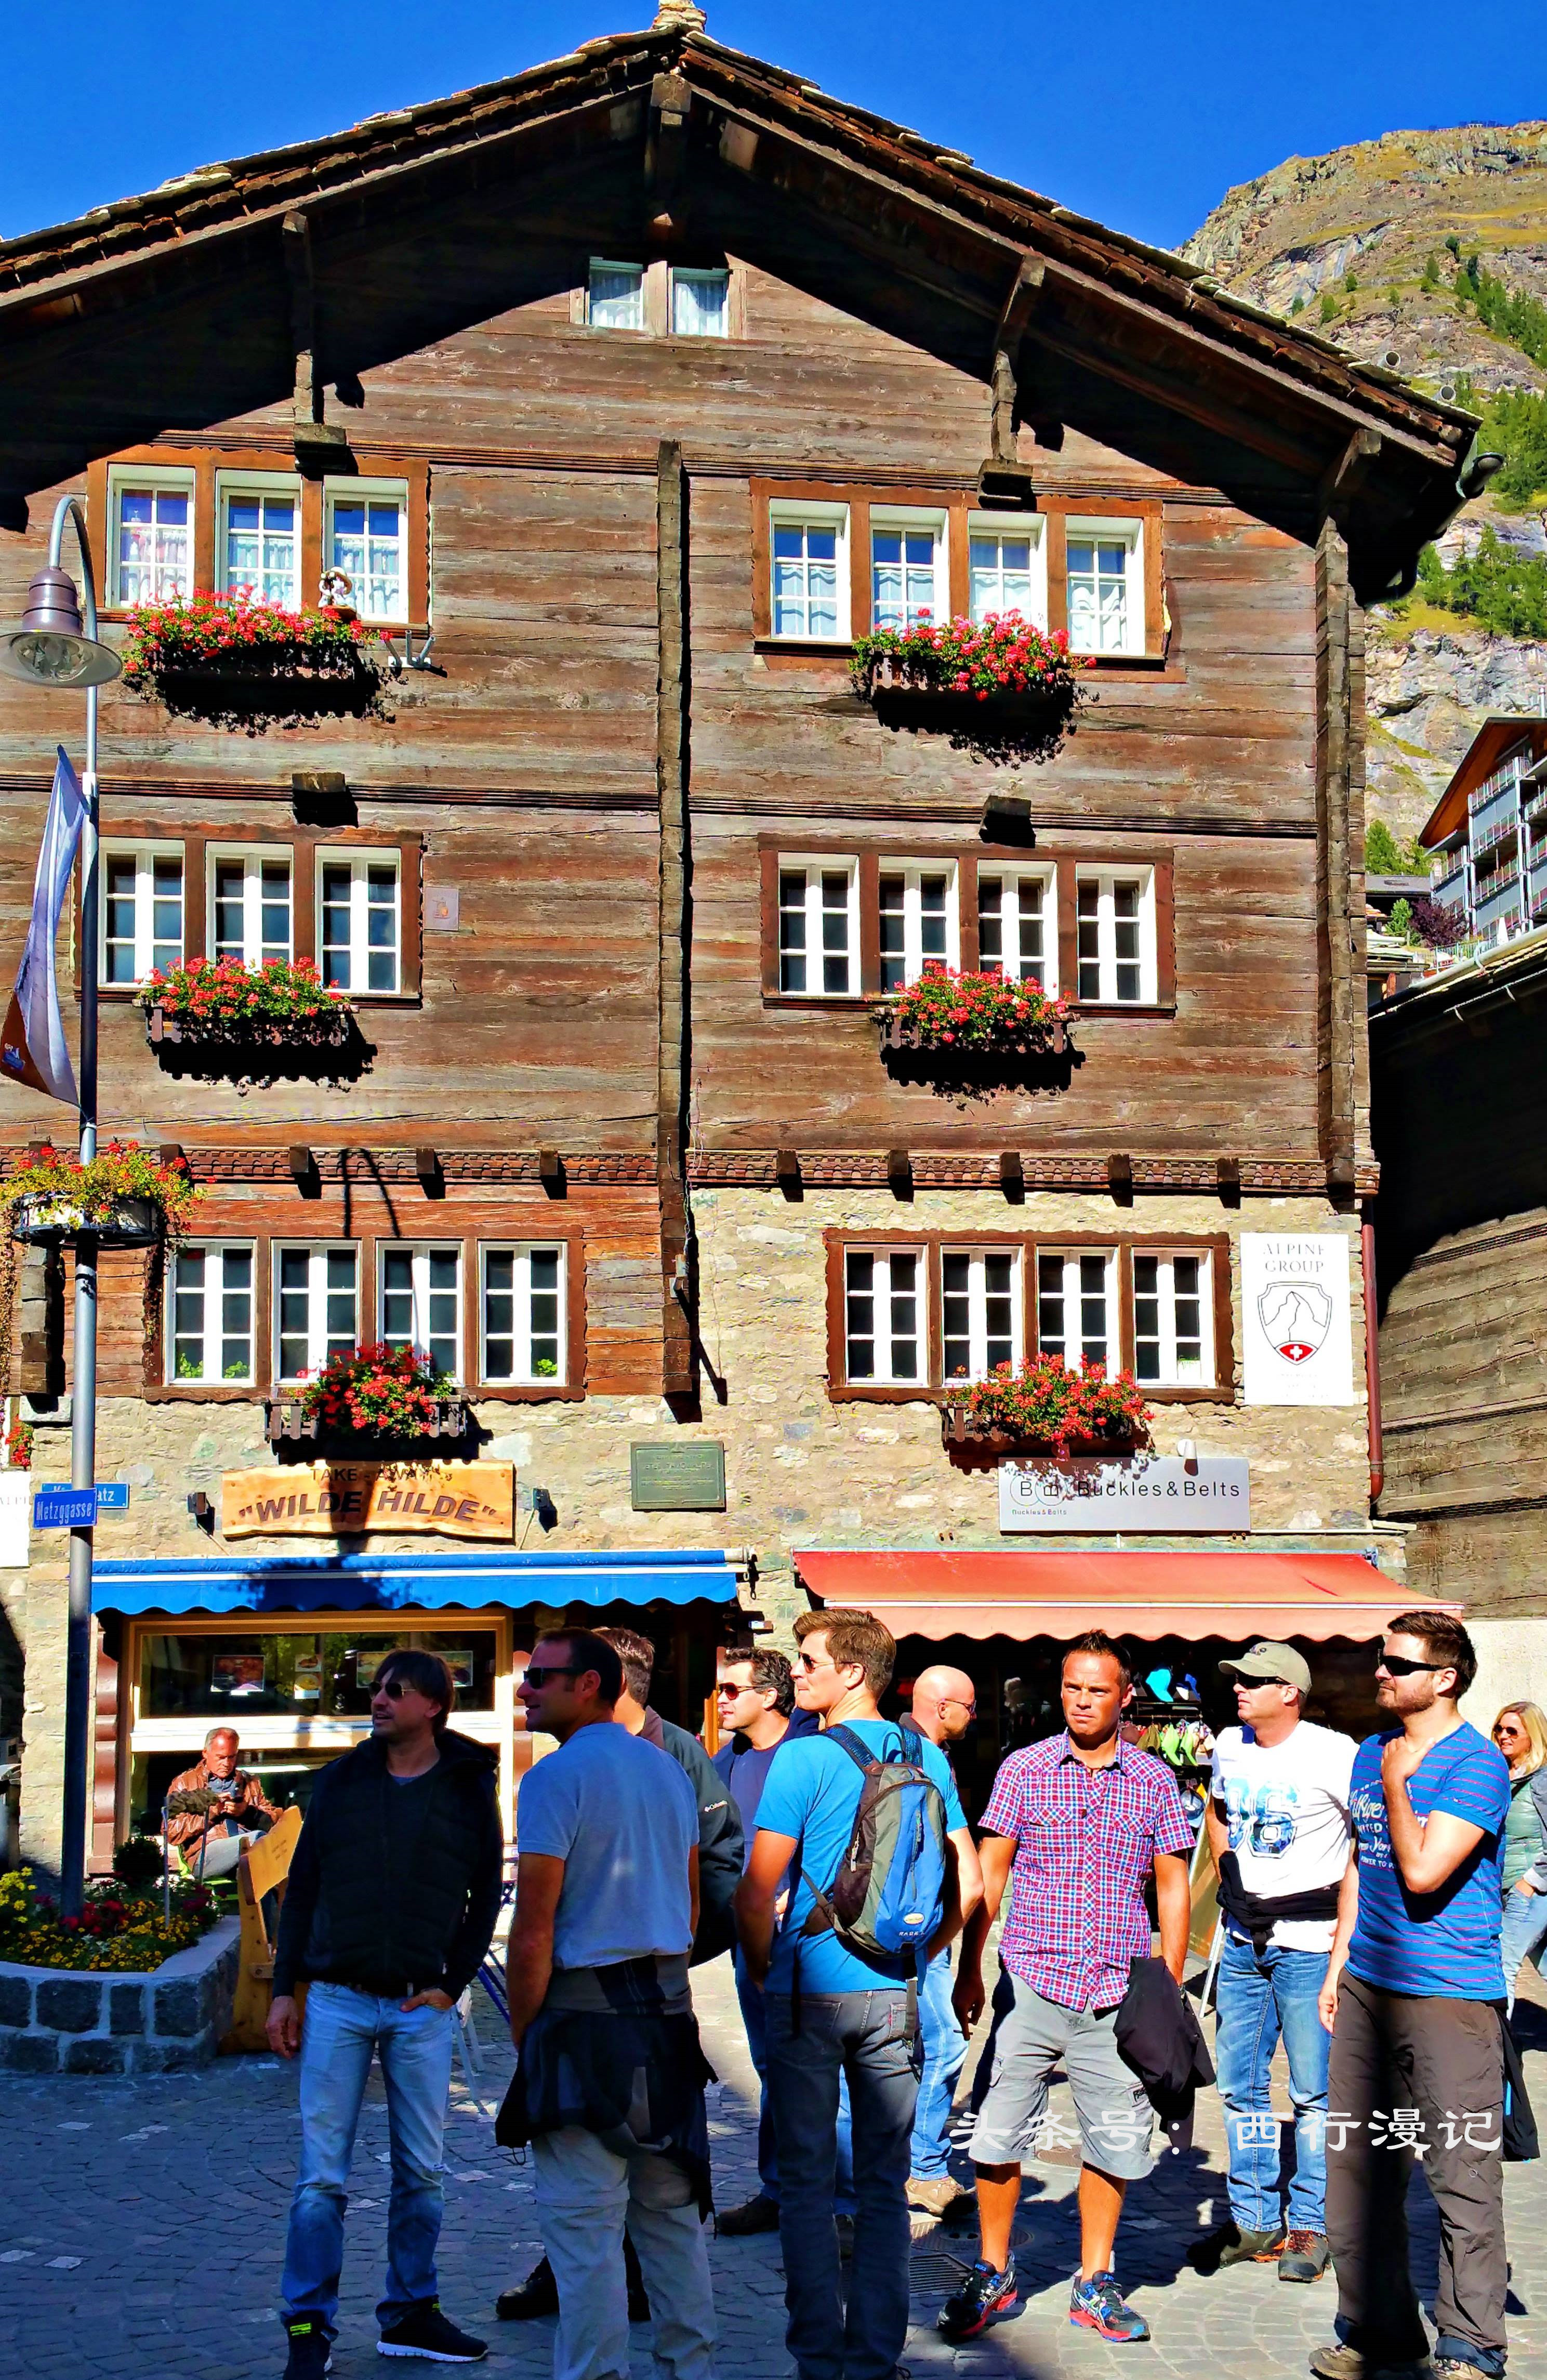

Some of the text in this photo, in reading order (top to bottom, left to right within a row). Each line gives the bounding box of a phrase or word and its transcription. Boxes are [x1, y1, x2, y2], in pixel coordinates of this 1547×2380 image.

[1265, 1260, 1324, 1272] GROUP
[310, 1468, 357, 1481] TAKE
[36, 1501, 92, 1524] Metzggasse
